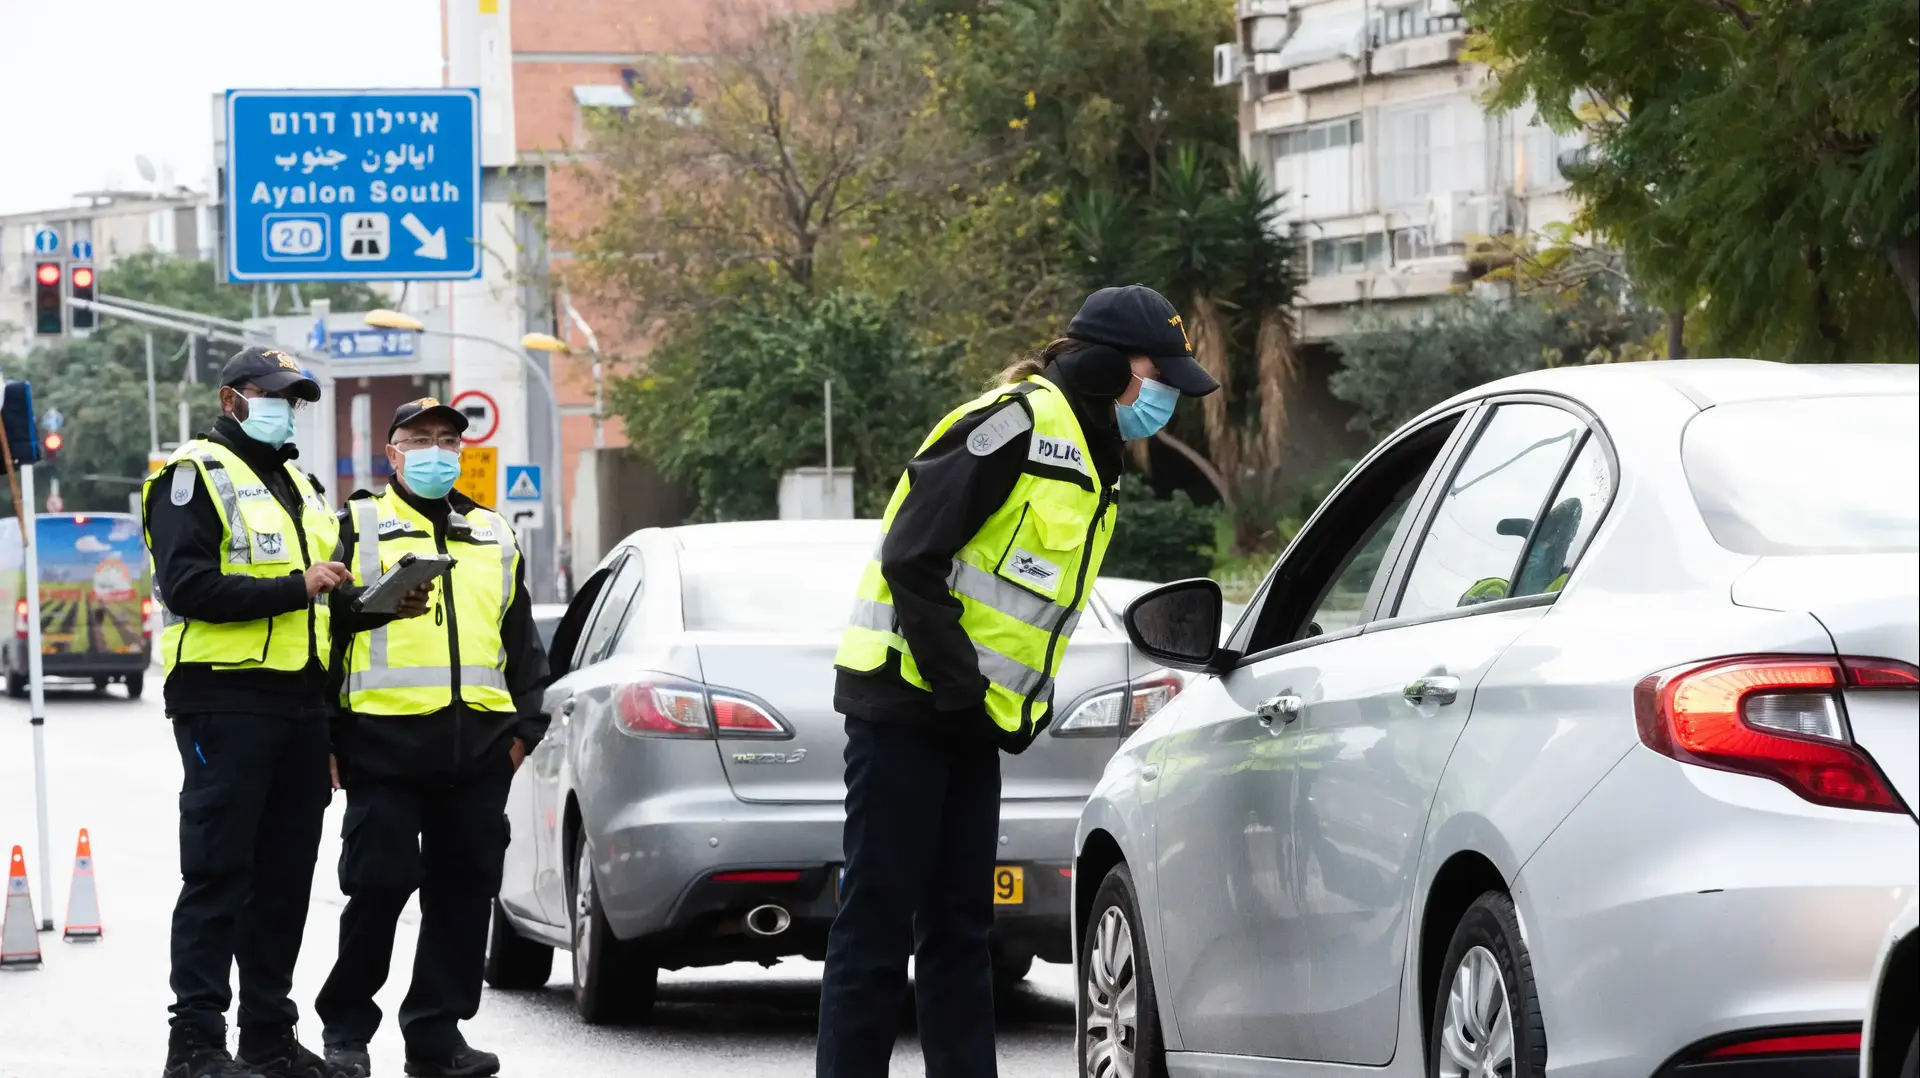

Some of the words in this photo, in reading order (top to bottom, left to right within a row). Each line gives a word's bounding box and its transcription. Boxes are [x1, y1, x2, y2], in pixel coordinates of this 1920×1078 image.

[269, 111, 336, 135] דרום
[351, 108, 439, 137] איילון
[274, 146, 348, 174] جنوب
[251, 181, 355, 209] Ayalon
[370, 179, 459, 203] South
[280, 228, 313, 248] 20
